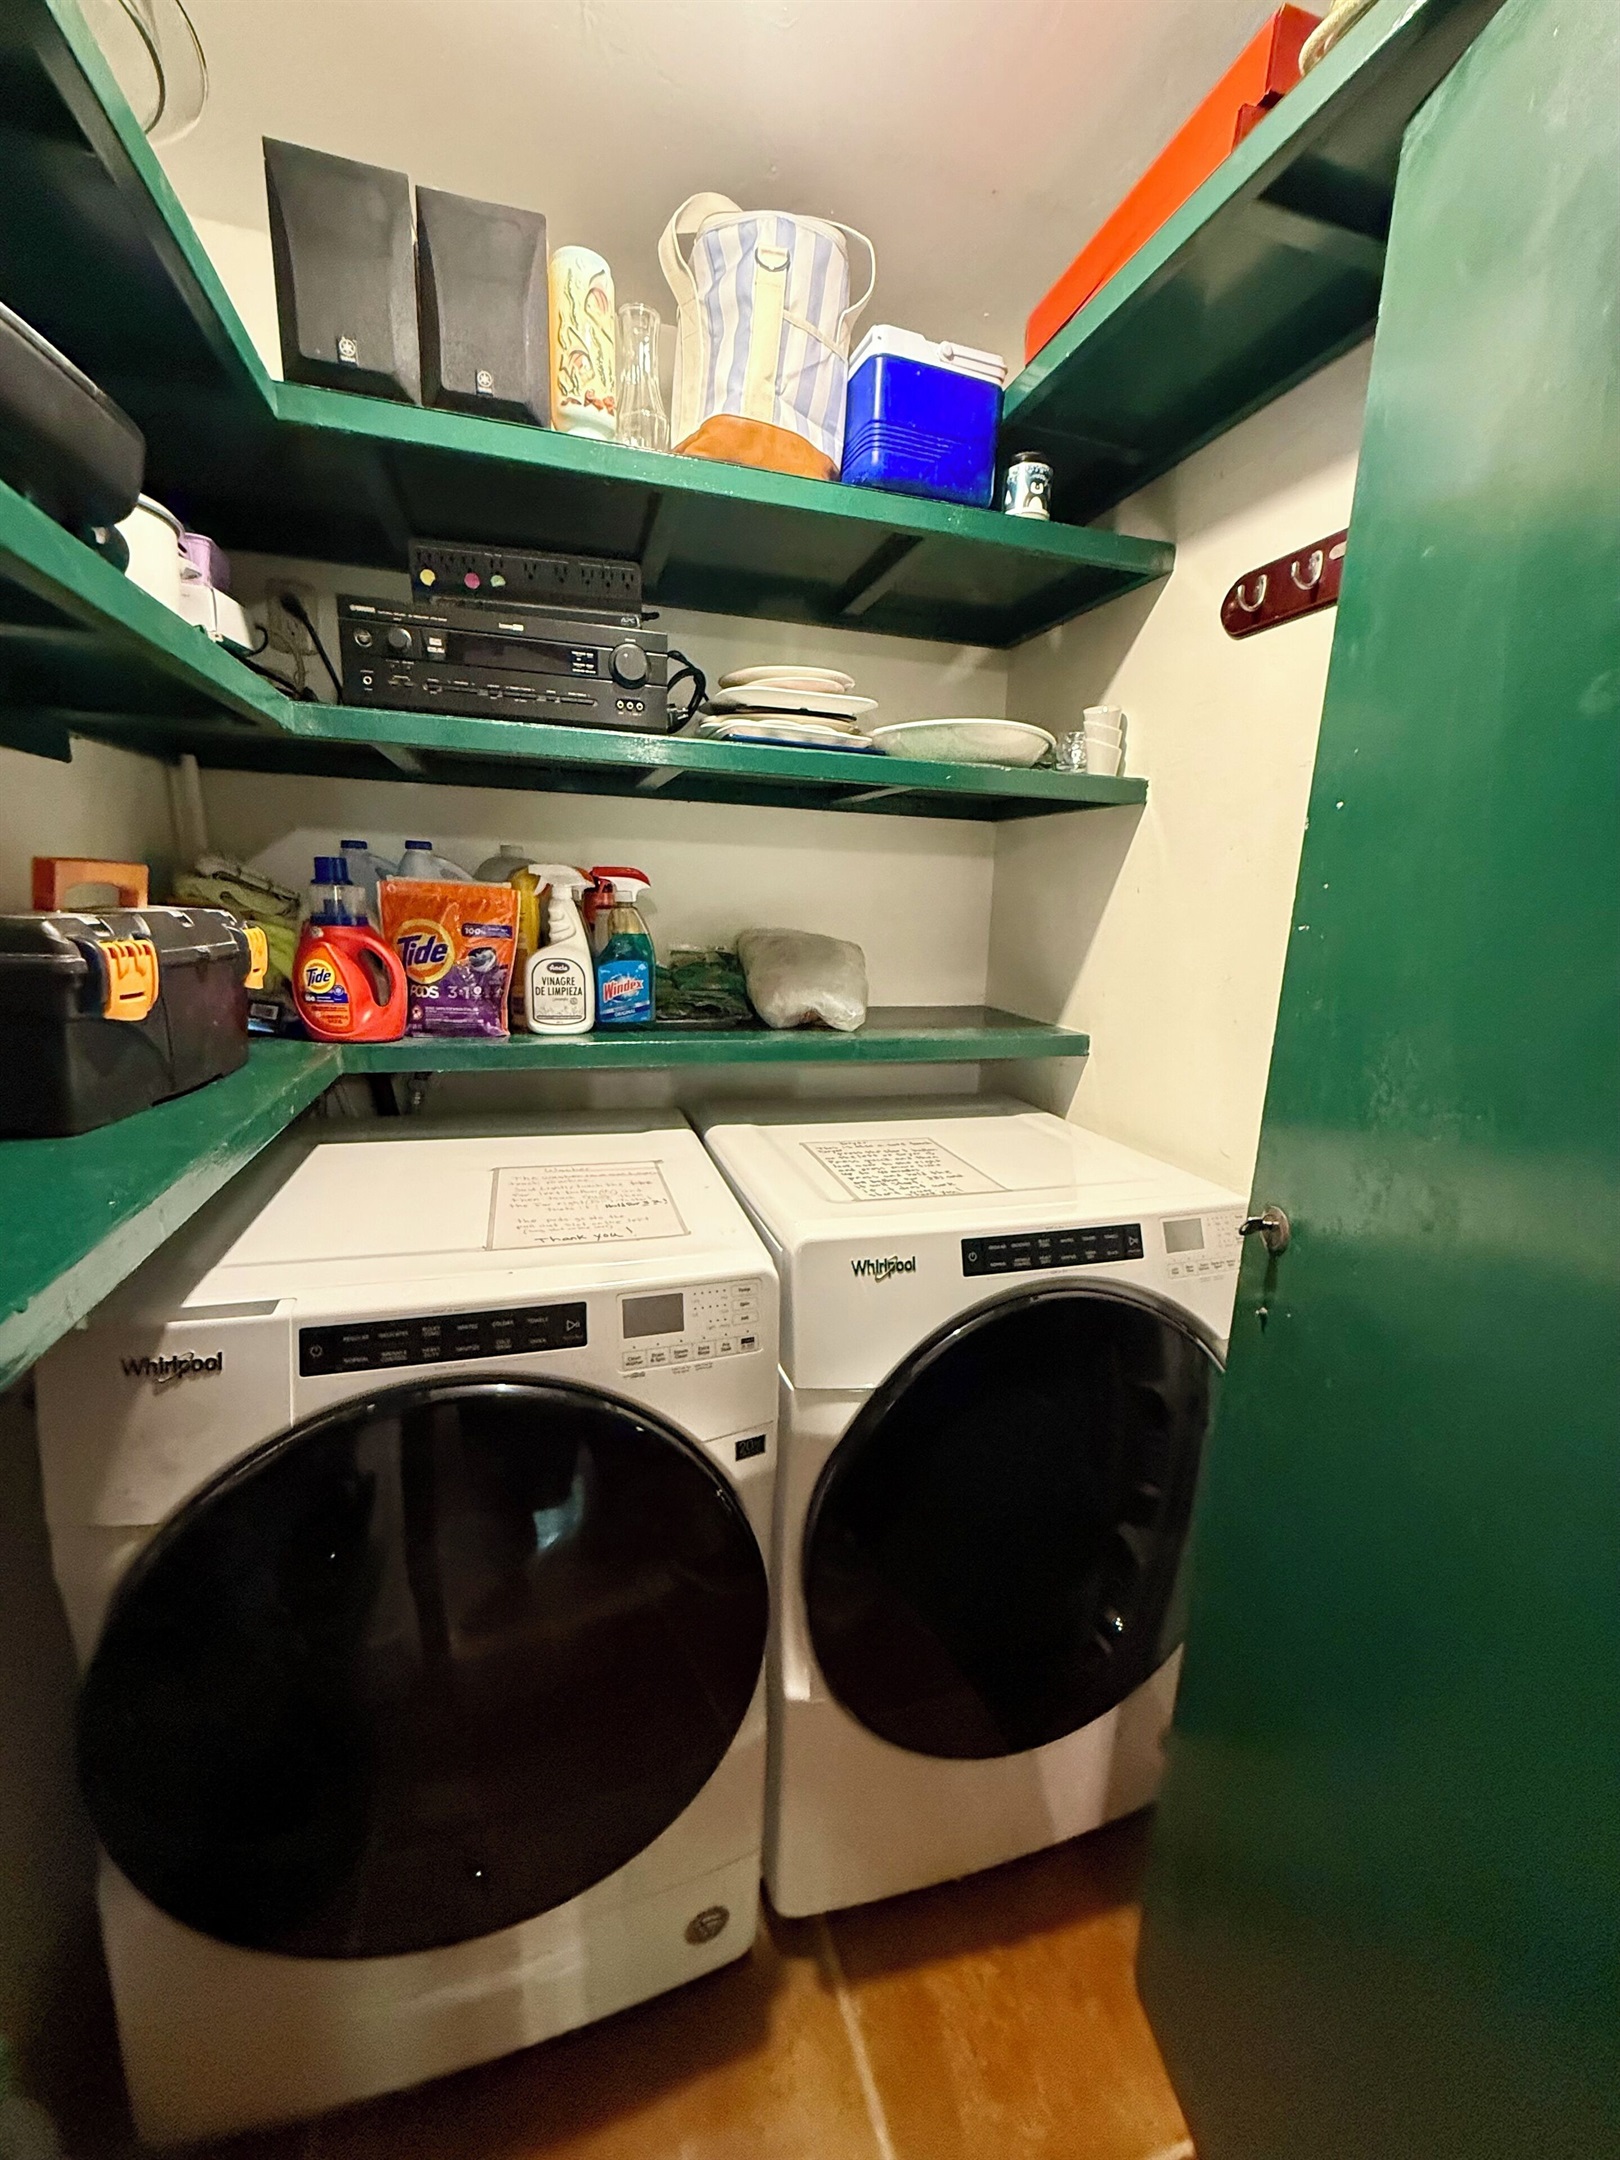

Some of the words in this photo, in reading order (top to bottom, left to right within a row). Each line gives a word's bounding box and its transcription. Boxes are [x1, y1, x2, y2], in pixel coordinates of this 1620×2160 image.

[397, 934, 449, 967] Tide
[306, 968, 332, 987] Tide
[541, 976, 576, 986] VINAGRE
[535, 986, 546, 996] DE
[547, 986, 583, 996] LIMPIEZA
[604, 979, 643, 1002] Windex
[534, 1233, 588, 1244] Thank
[850, 1254, 916, 1280] Whirlpool
[119, 1351, 224, 1381] Whirlpool
